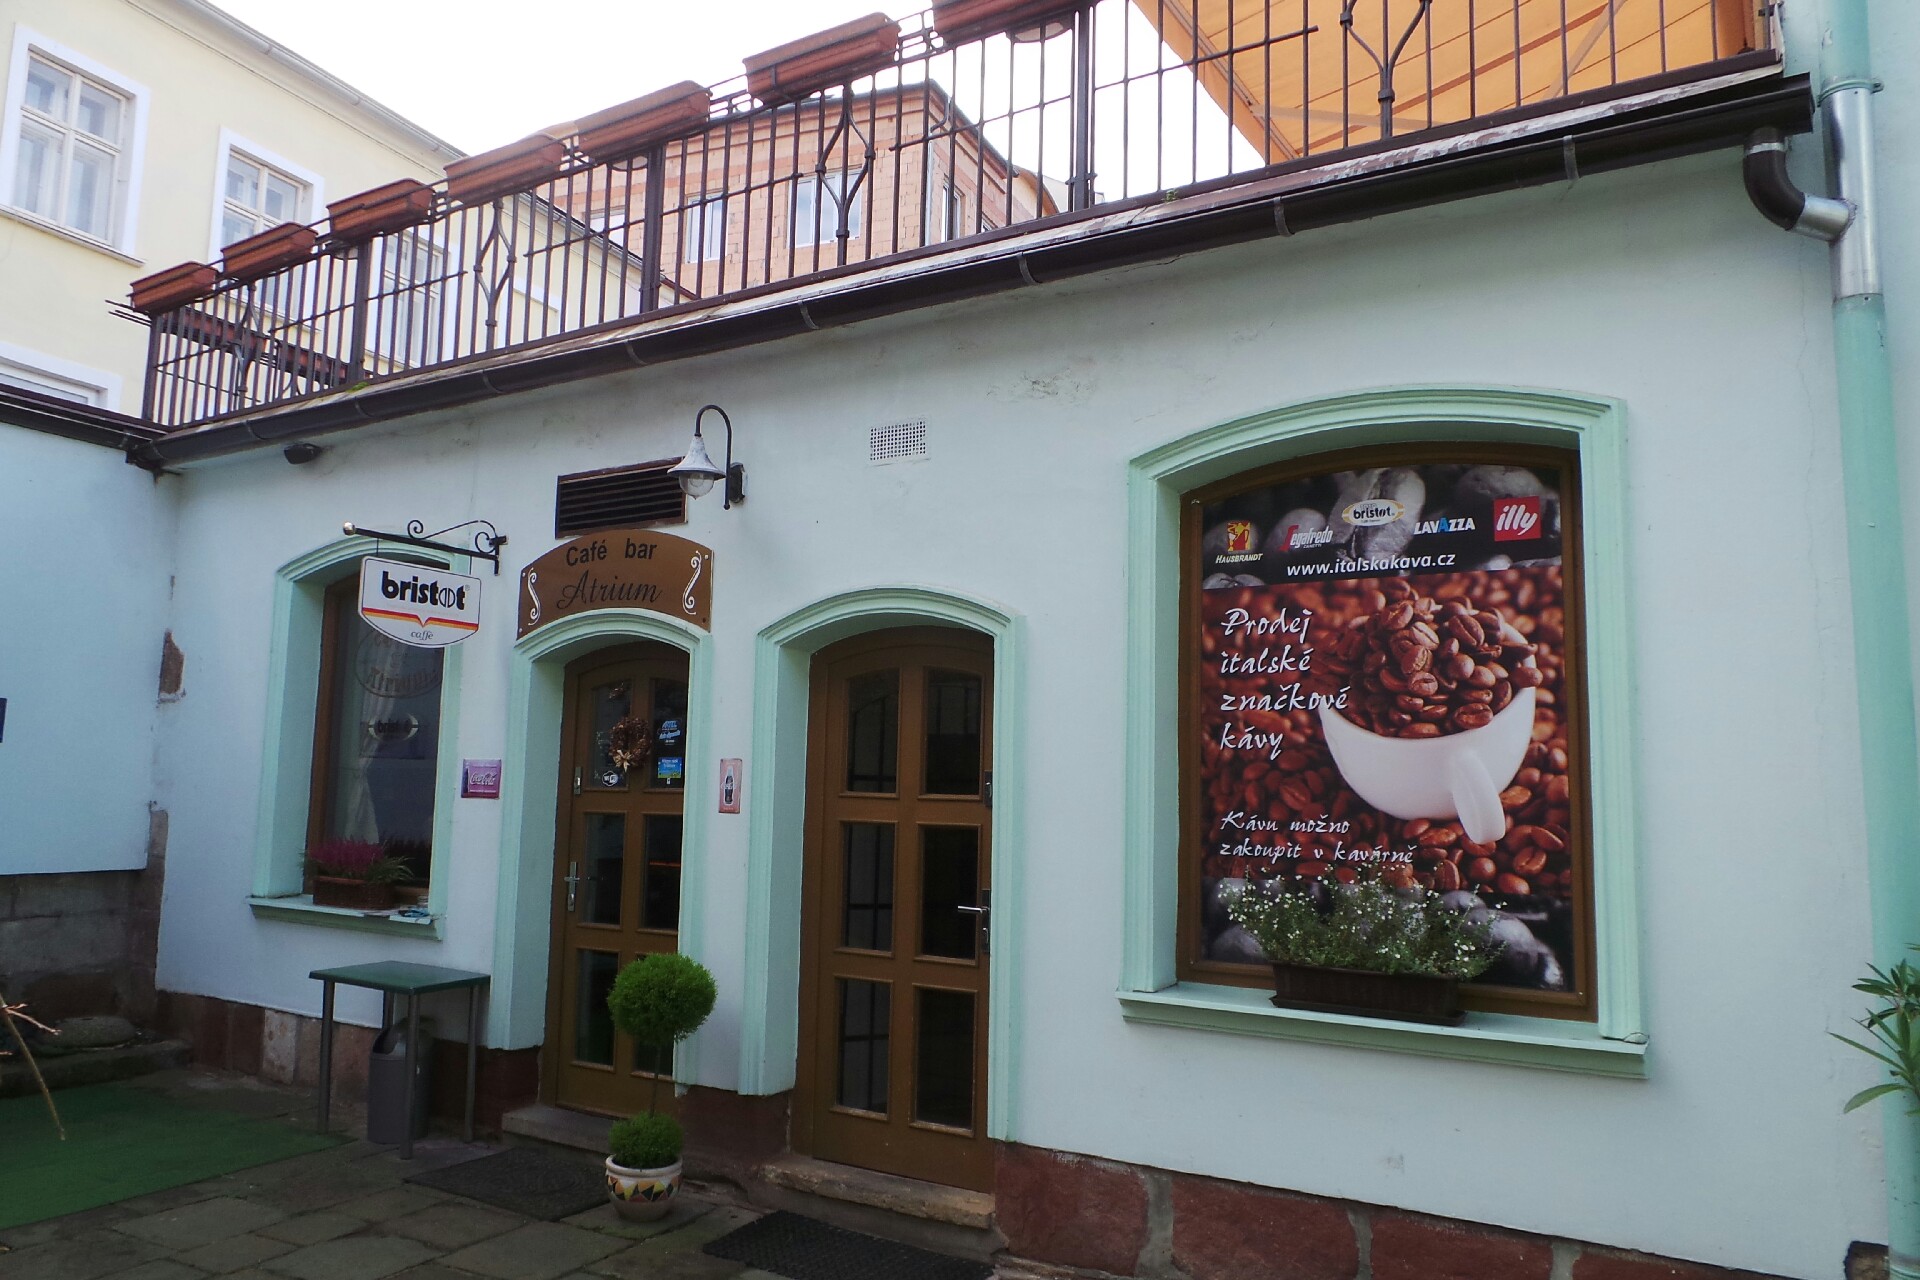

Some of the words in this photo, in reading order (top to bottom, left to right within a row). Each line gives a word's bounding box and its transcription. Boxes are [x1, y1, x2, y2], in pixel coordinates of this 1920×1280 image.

[1353, 506, 1391, 520] bristot
[1413, 517, 1476, 536] LAVAZZA
[1496, 504, 1538, 536] illy
[566, 539, 608, 566] Café
[625, 537, 658, 560] bar
[1215, 552, 1264, 564] HAUSBRANDT
[1287, 554, 1456, 577] www.italskakava.cz
[381, 570, 466, 611] bristot
[557, 569, 663, 610] Atrium
[1220, 607, 1313, 644] Prodej
[1220, 644, 1314, 674] italské
[1220, 682, 1351, 712] značkové
[1220, 722, 1284, 761] kávy
[1219, 810, 1279, 831] Kávu
[1289, 814, 1351, 833] možno
[1219, 838, 1302, 864] zakoupit
[1313, 849, 1324, 859] v
[1334, 841, 1418, 864] kavárně
